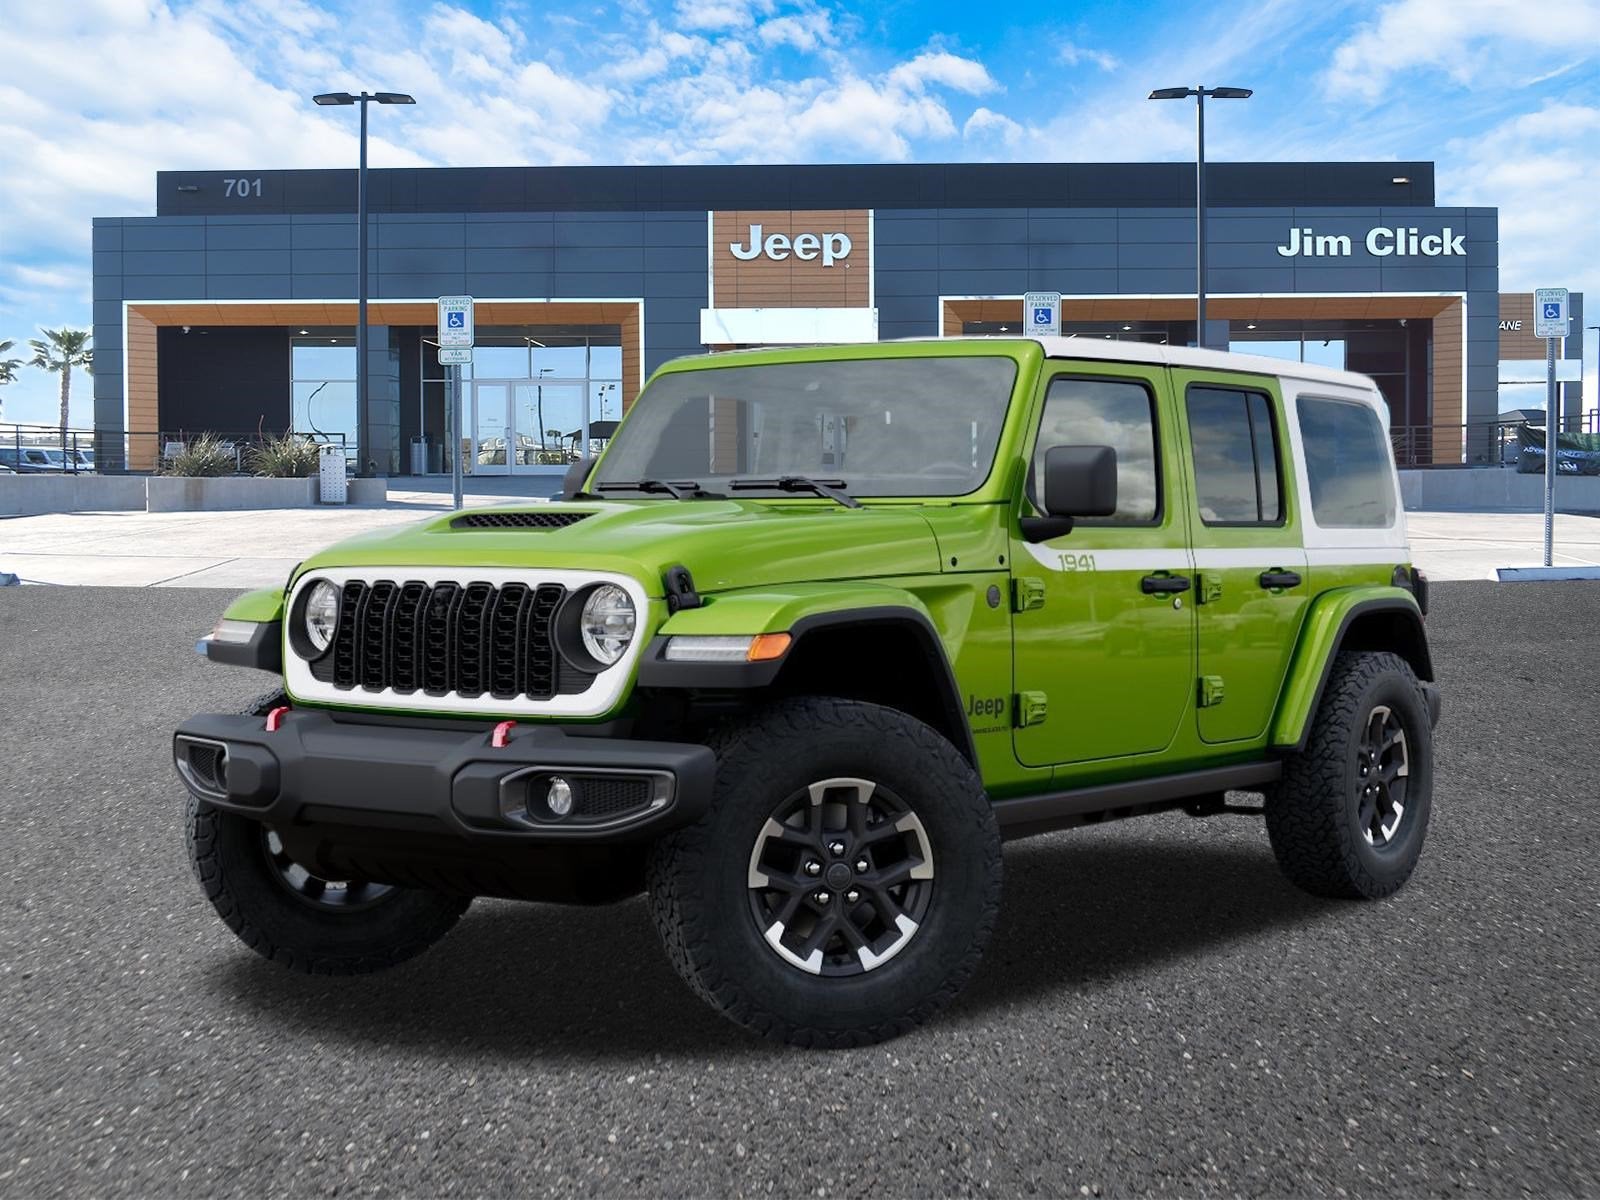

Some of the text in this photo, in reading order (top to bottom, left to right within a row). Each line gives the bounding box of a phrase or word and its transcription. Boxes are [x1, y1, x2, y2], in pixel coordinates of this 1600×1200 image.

[223, 178, 262, 197] 701
[730, 224, 852, 267] Jeep
[1277, 227, 1467, 257] Jim Click
[1057, 554, 1096, 573] 1941
[966, 694, 1005, 719] Jeep
